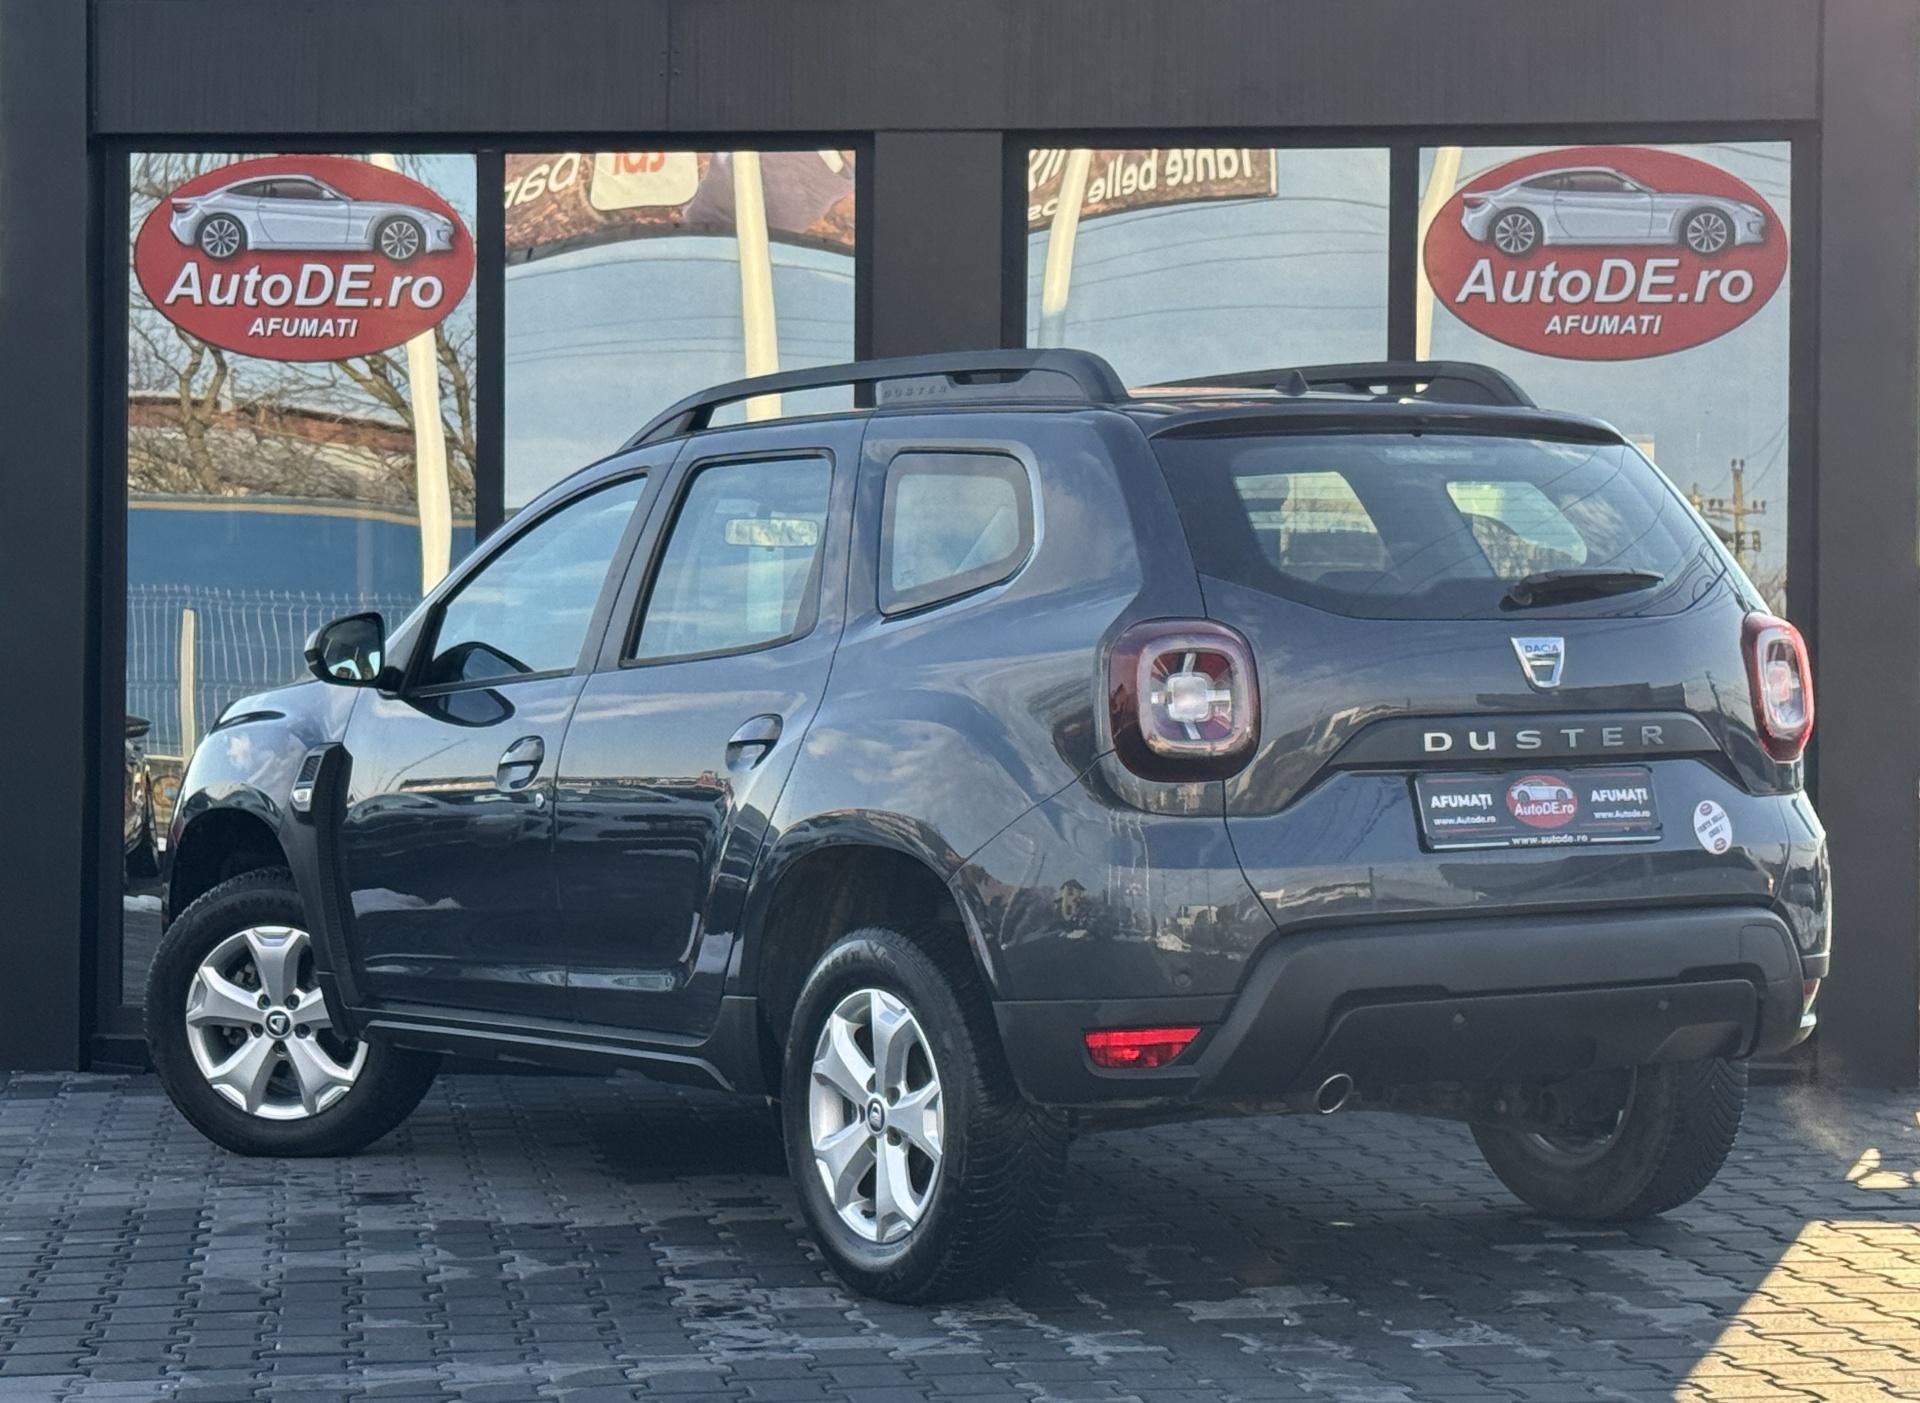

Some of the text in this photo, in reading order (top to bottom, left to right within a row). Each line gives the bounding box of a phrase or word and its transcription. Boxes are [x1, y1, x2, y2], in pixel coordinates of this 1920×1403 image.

[165, 262, 443, 308] AutoDE.ro
[1455, 259, 1753, 304] AutoDE.ro
[248, 318, 359, 338] AFUMATI
[1544, 315, 1662, 335] AFUMATI
[1525, 644, 1559, 653] DACIA
[1424, 726, 1664, 752] DUSTER
[1514, 801, 1575, 816] AutoDE.ro
